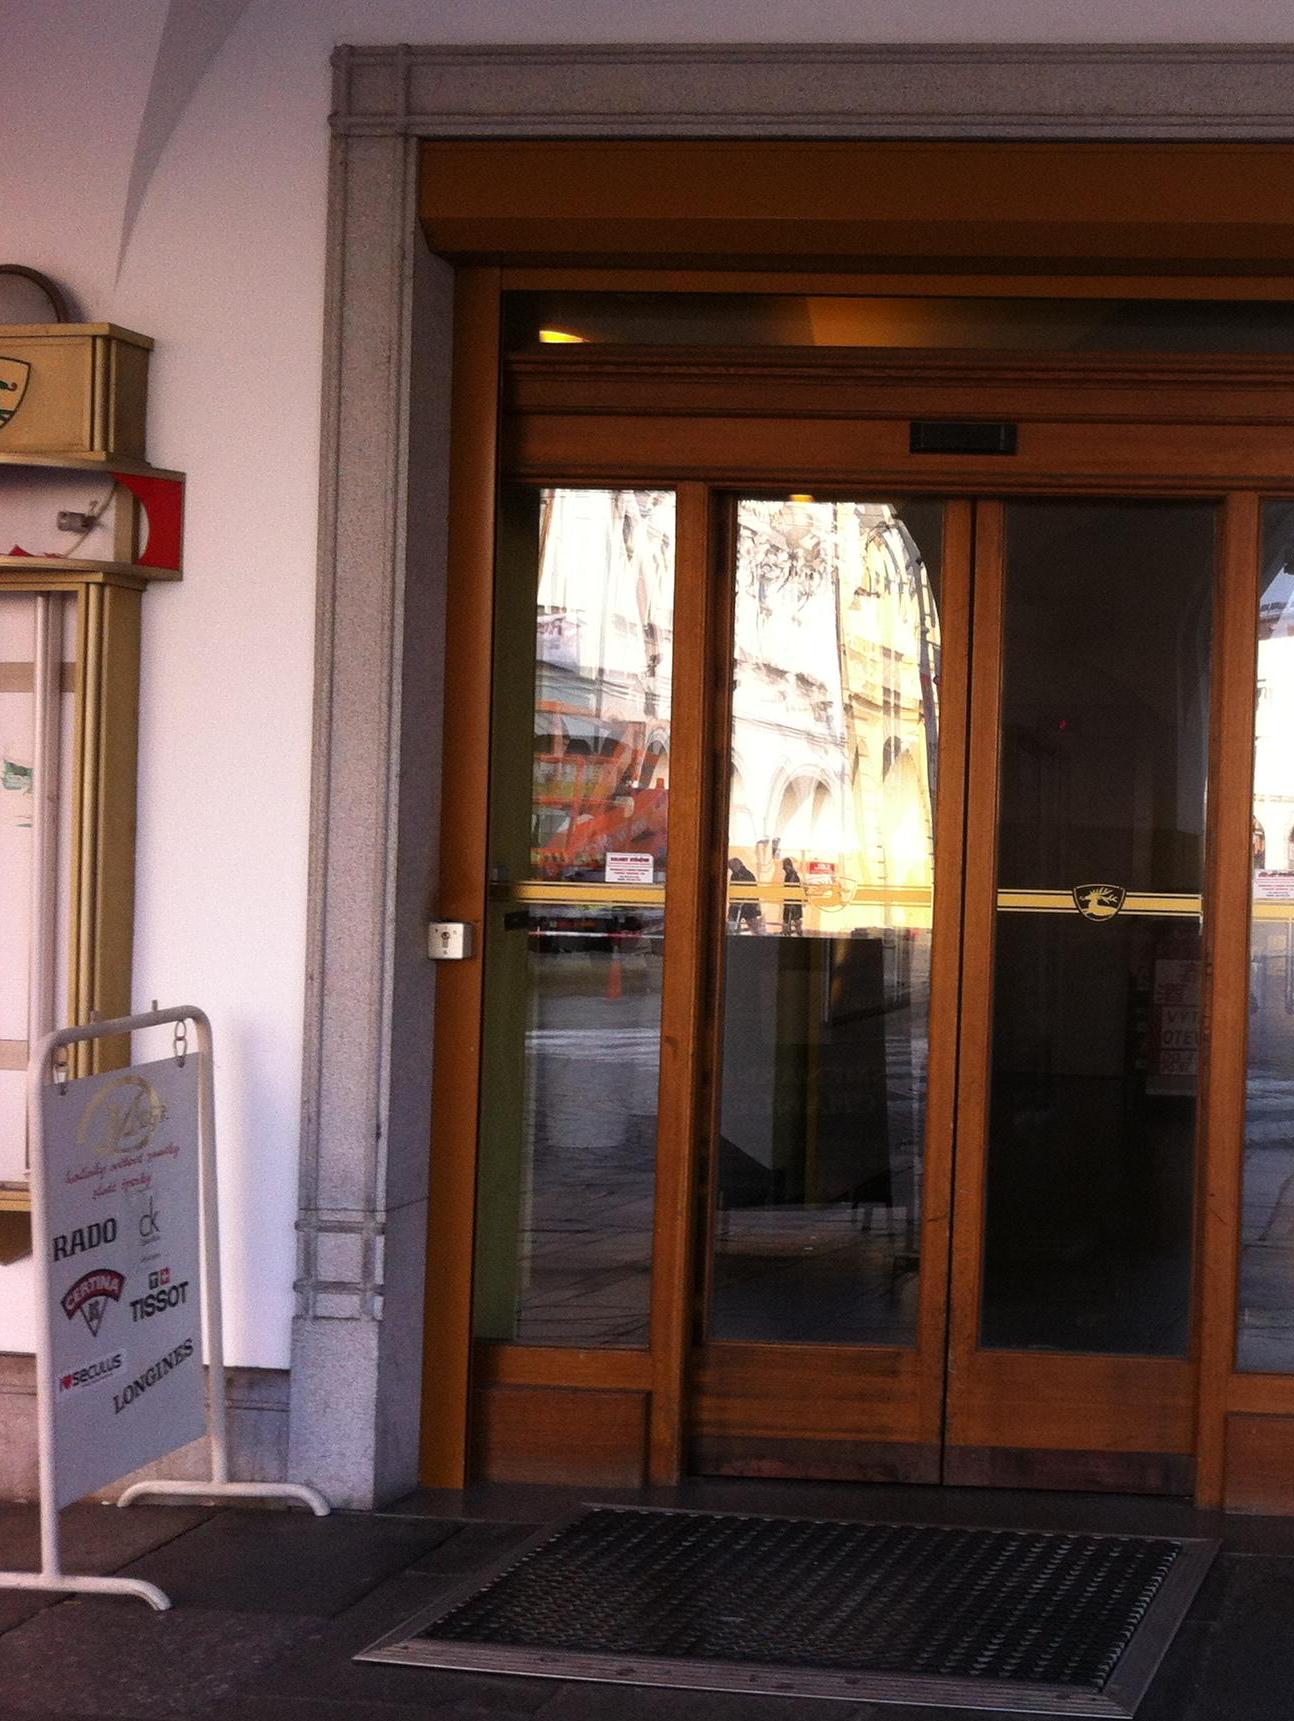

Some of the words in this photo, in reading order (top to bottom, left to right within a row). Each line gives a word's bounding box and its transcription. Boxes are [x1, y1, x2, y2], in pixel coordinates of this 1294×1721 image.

[52, 1217, 117, 1261] RADO
[130, 1281, 189, 1322] TISSOT
[113, 1338, 194, 1415] LONGINES
